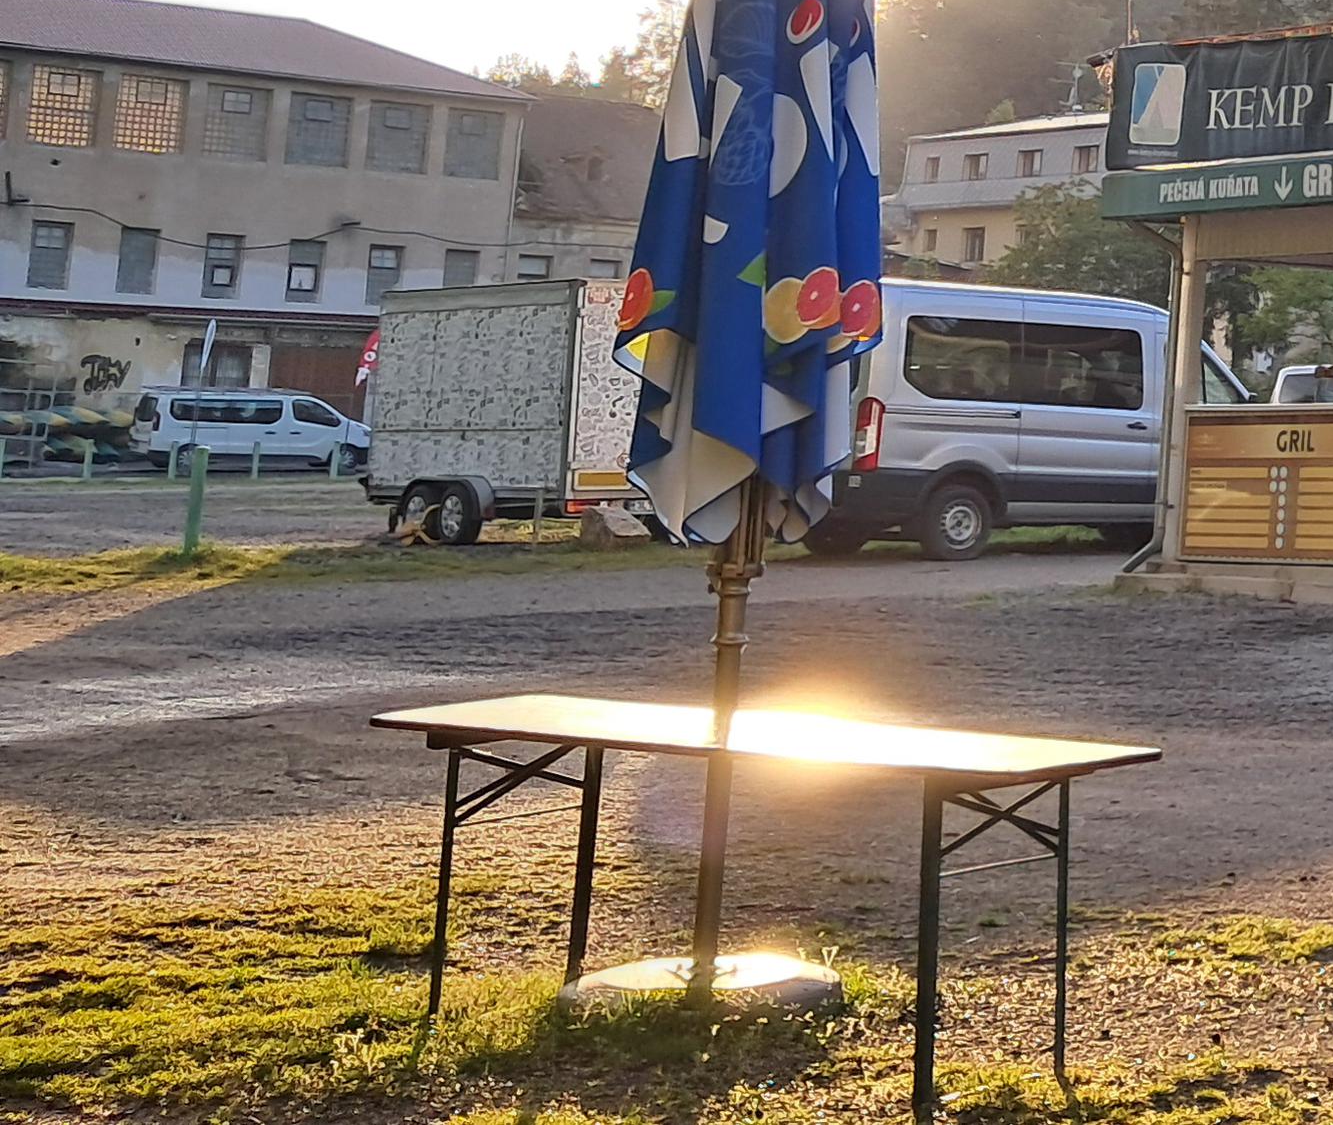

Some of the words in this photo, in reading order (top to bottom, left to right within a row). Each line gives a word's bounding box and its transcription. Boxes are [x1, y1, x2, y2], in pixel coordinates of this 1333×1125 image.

[1205, 83, 1314, 131] KEMP
[1159, 176, 1205, 204] PEČENÁ
[1208, 173, 1260, 200] KUŘATA
[1276, 428, 1315, 453] GRIL
